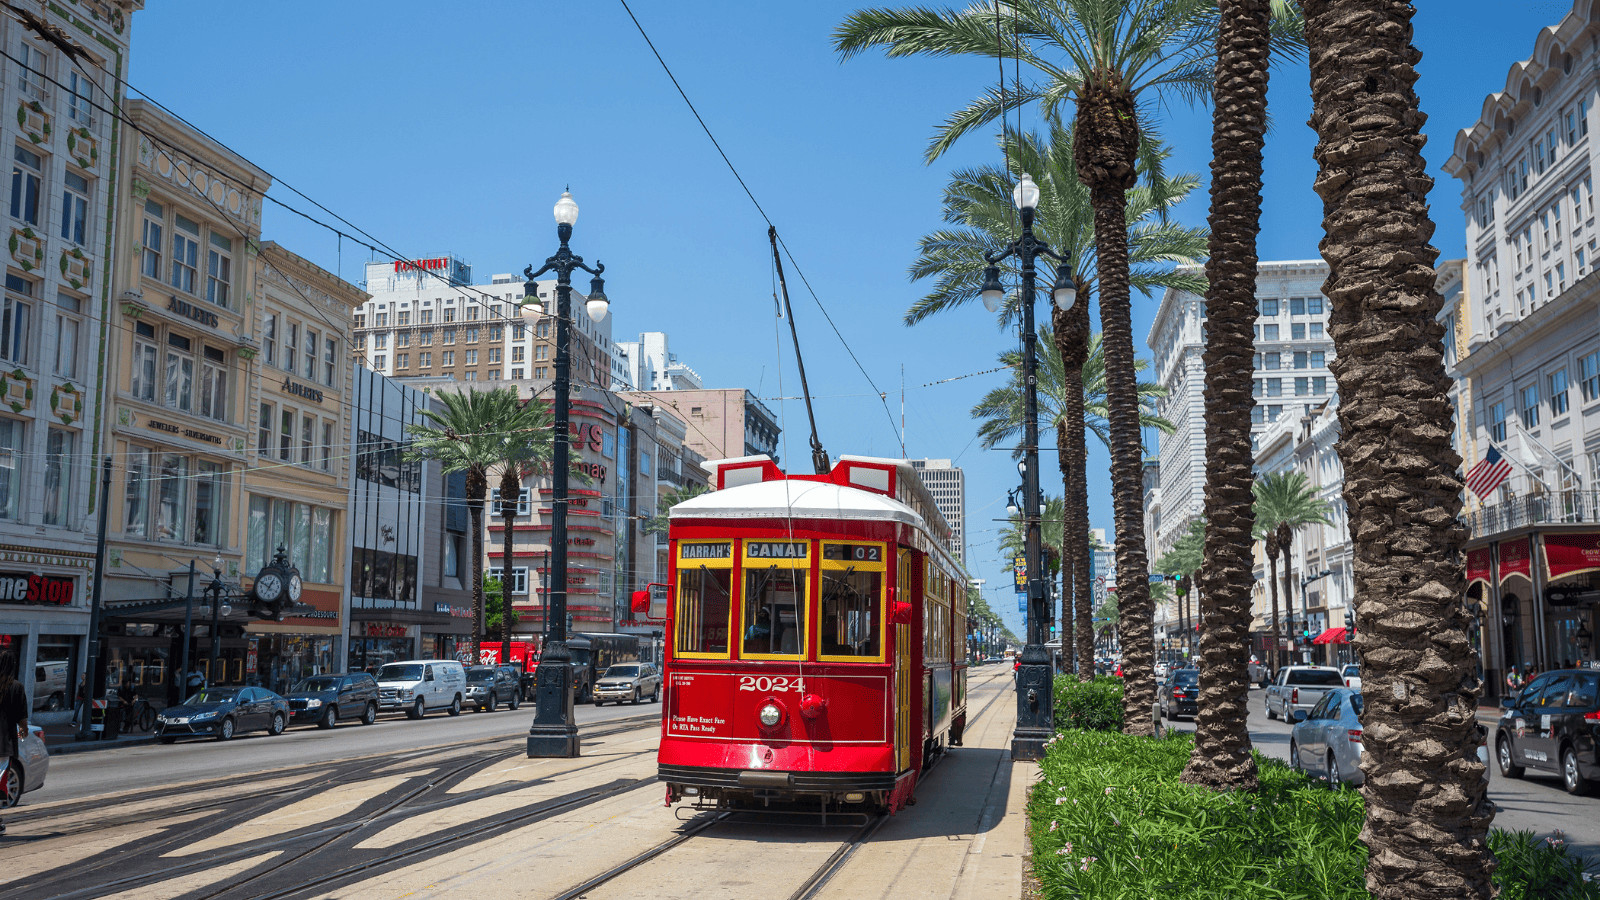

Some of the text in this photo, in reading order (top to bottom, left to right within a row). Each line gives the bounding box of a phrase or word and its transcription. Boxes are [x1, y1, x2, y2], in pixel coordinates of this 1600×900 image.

[168, 295, 218, 328] ADLER'S
[281, 376, 323, 402] ADLER'S
[148, 420, 222, 444] JEWELERS SILVERSMITHS
[568, 498, 588, 507] eauty
[683, 545, 731, 558] HARRAH'S
[747, 544, 806, 558] CANAL
[739, 676, 806, 692] 2024
[701, 726, 716, 734] Ready
